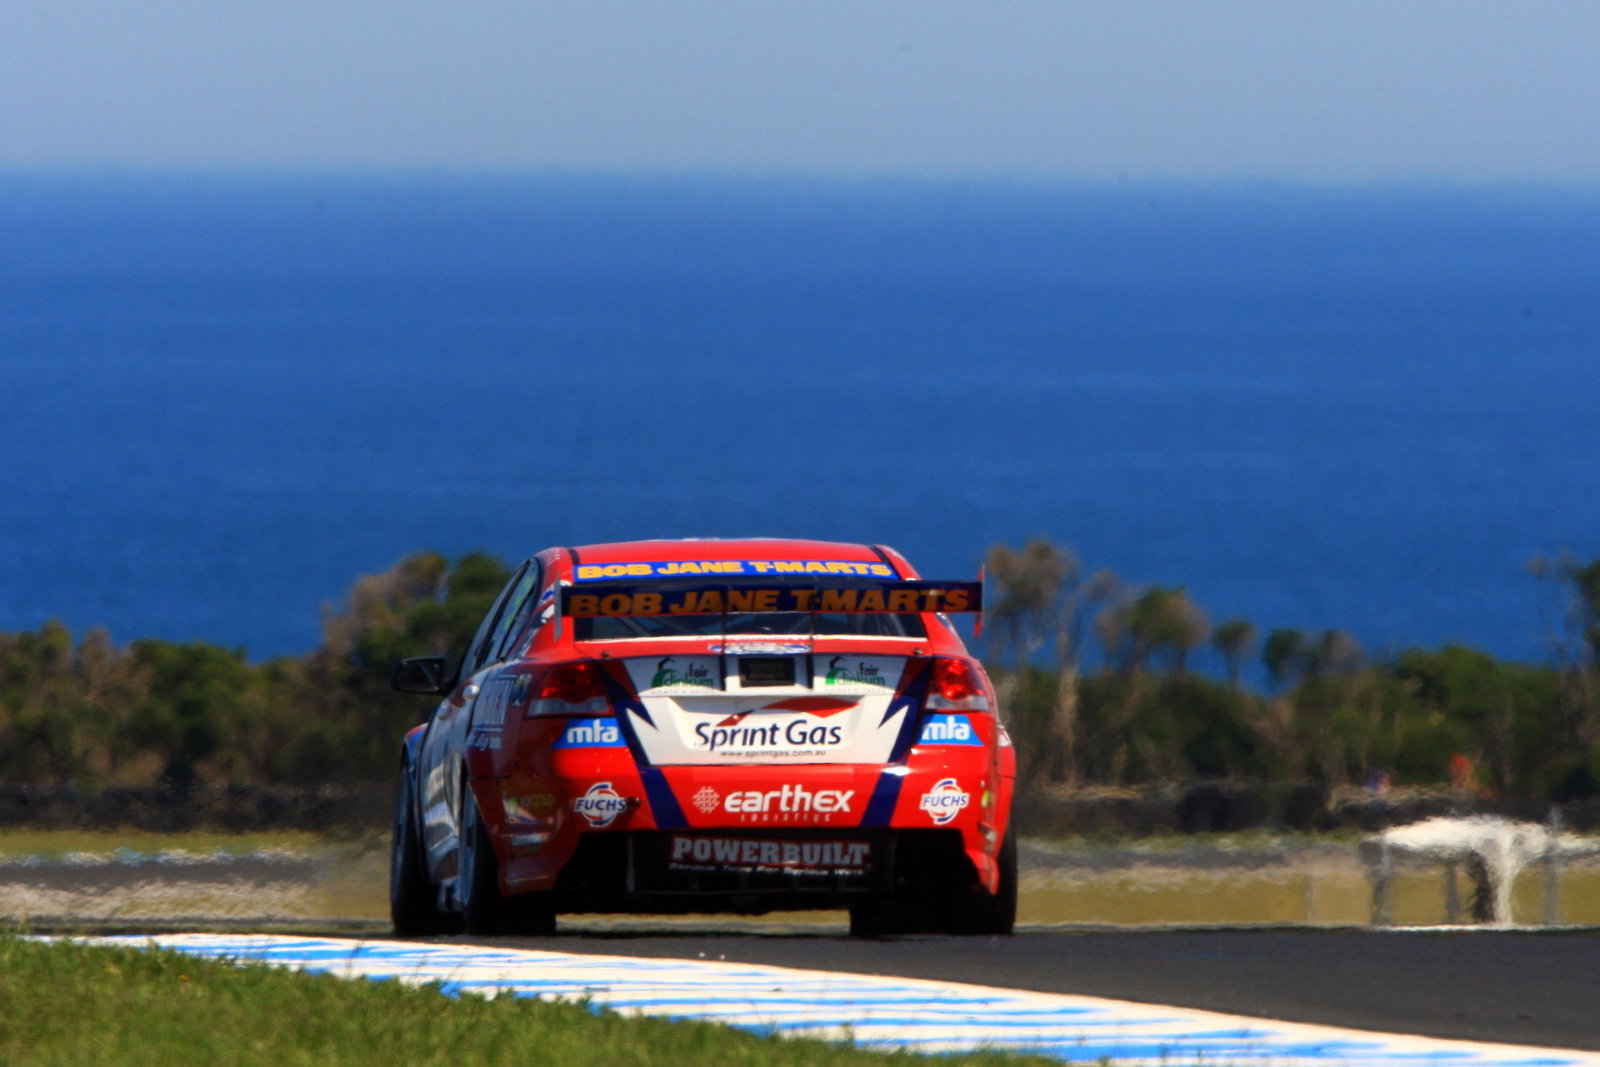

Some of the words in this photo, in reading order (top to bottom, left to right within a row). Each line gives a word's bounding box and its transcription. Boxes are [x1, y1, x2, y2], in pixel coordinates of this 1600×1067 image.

[577, 564, 653, 579] BOB
[657, 562, 744, 575] JANE
[748, 562, 892, 576] T-MARTS
[568, 593, 663, 615] BOB
[669, 590, 779, 613] JANE
[791, 589, 970, 613] T-MARTS
[688, 662, 709, 678] fair
[859, 661, 879, 677] fair
[695, 721, 780, 751] Sprint
[785, 719, 842, 745] Gas
[720, 749, 826, 758] www.sprintgas.com.au
[576, 799, 627, 811] FUCHS
[922, 795, 967, 808] FUCHS
[672, 836, 870, 866] POWERBUILT
